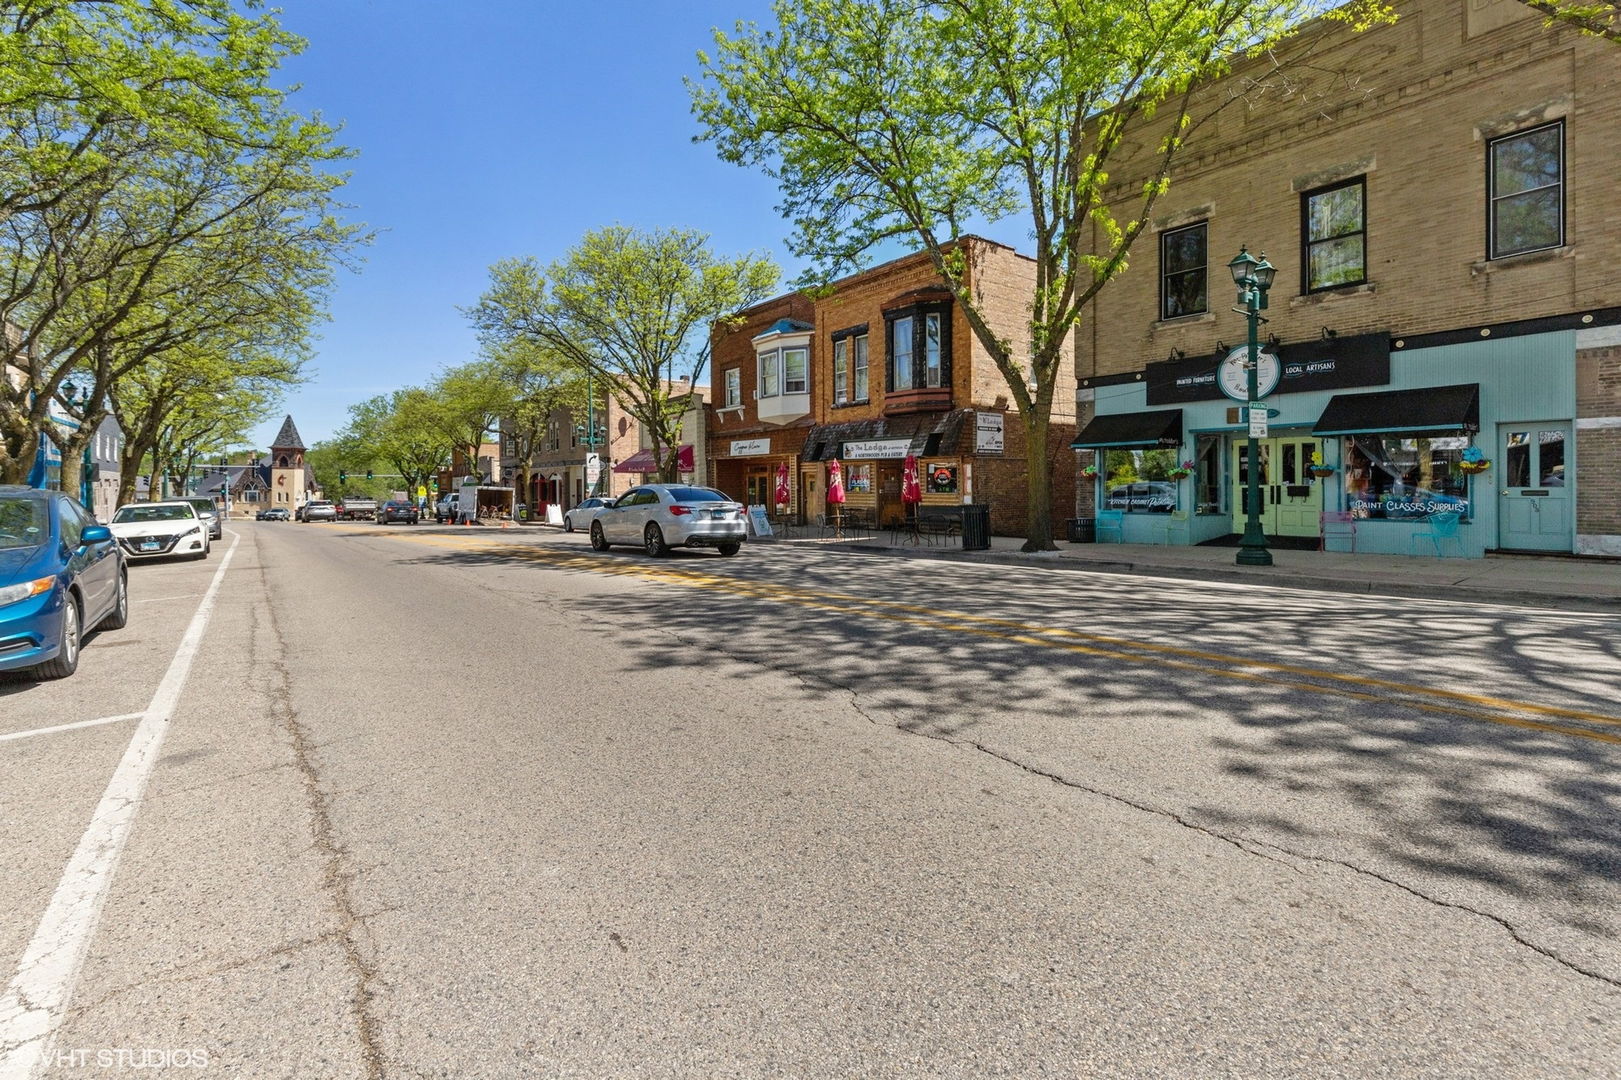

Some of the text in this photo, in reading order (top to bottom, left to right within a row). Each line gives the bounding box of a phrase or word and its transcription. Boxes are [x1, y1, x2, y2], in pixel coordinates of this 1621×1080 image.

[1285, 362, 1336, 374] LOCAL ARTISANS
[863, 443, 888, 452] Lodge
[1355, 500, 1465, 513] PAINT CLASSES SUPPLIES
